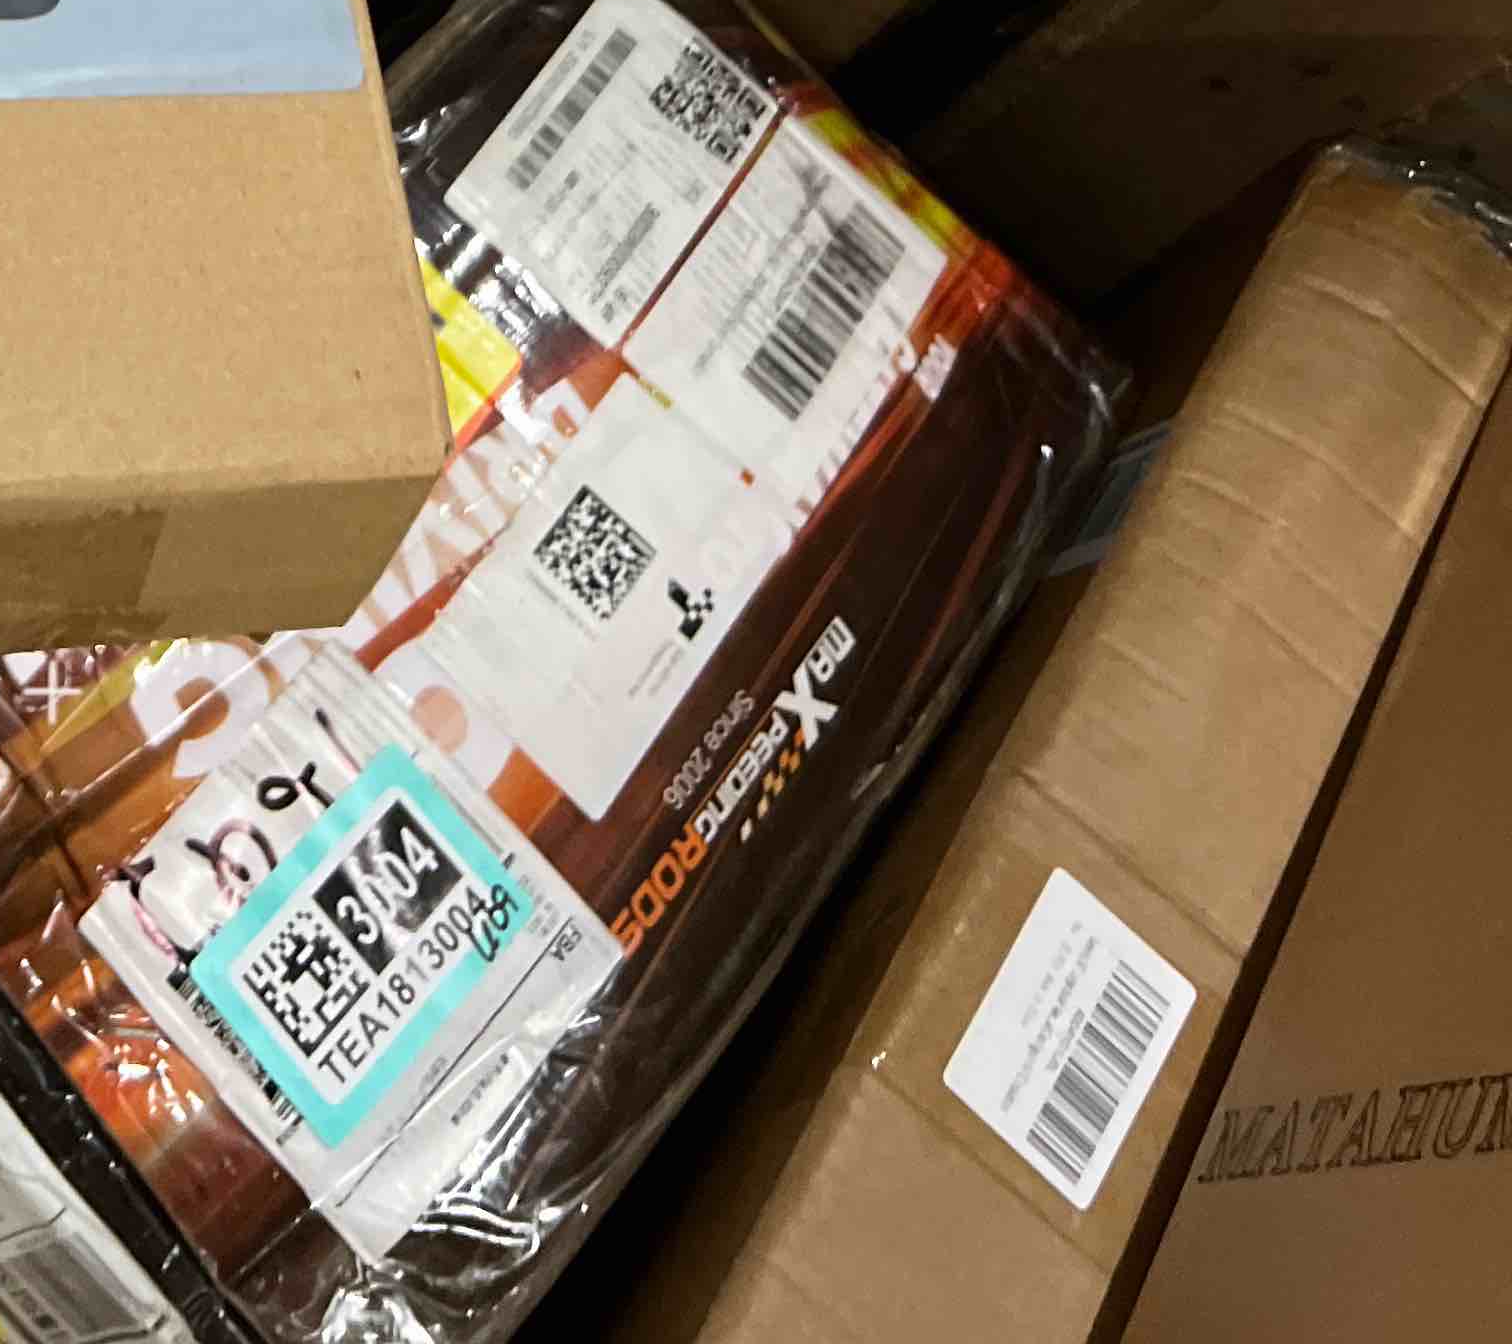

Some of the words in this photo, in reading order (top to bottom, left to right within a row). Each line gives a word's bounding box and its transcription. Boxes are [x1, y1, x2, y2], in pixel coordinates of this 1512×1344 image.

[705, 689, 756, 753] Since
[662, 746, 715, 812] 2006
[548, 920, 584, 961] FBA
[318, 883, 492, 1086] TEA1813004
